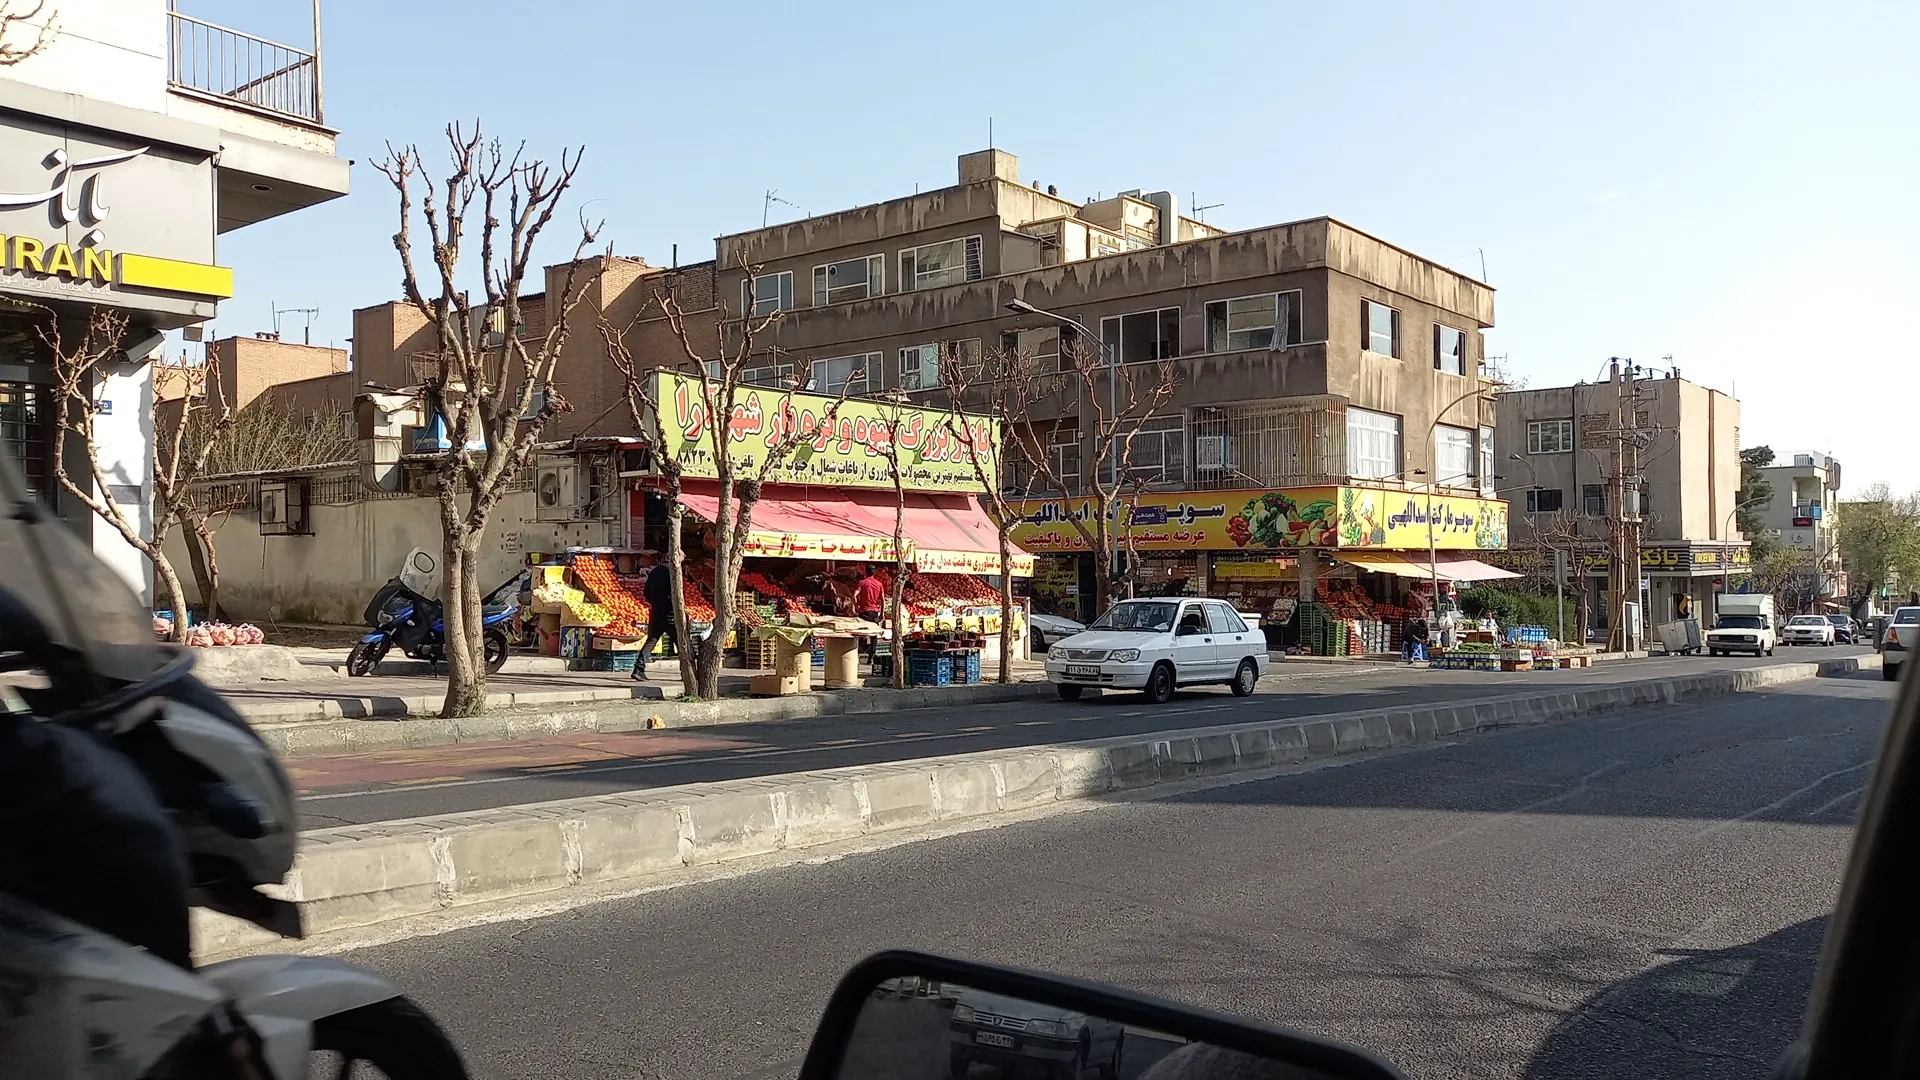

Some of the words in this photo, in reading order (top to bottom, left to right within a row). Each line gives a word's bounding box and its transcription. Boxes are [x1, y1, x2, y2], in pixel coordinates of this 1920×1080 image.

[836, 417, 852, 455] و
[899, 412, 949, 461] بزرگ
[786, 459, 807, 476] جنوب
[817, 457, 836, 476] شمال
[838, 459, 857, 479] باغات
[860, 461, 866, 480] از
[901, 463, 931, 484] محصولات
[954, 468, 973, 484] مستقیم
[933, 469, 952, 484] بهترین
[1135, 512, 1156, 520] هجدهم
[1132, 529, 1170, 544] مستقیم
[1172, 527, 1206, 546] عرضه
[1641, 546, 1679, 571] بانک
